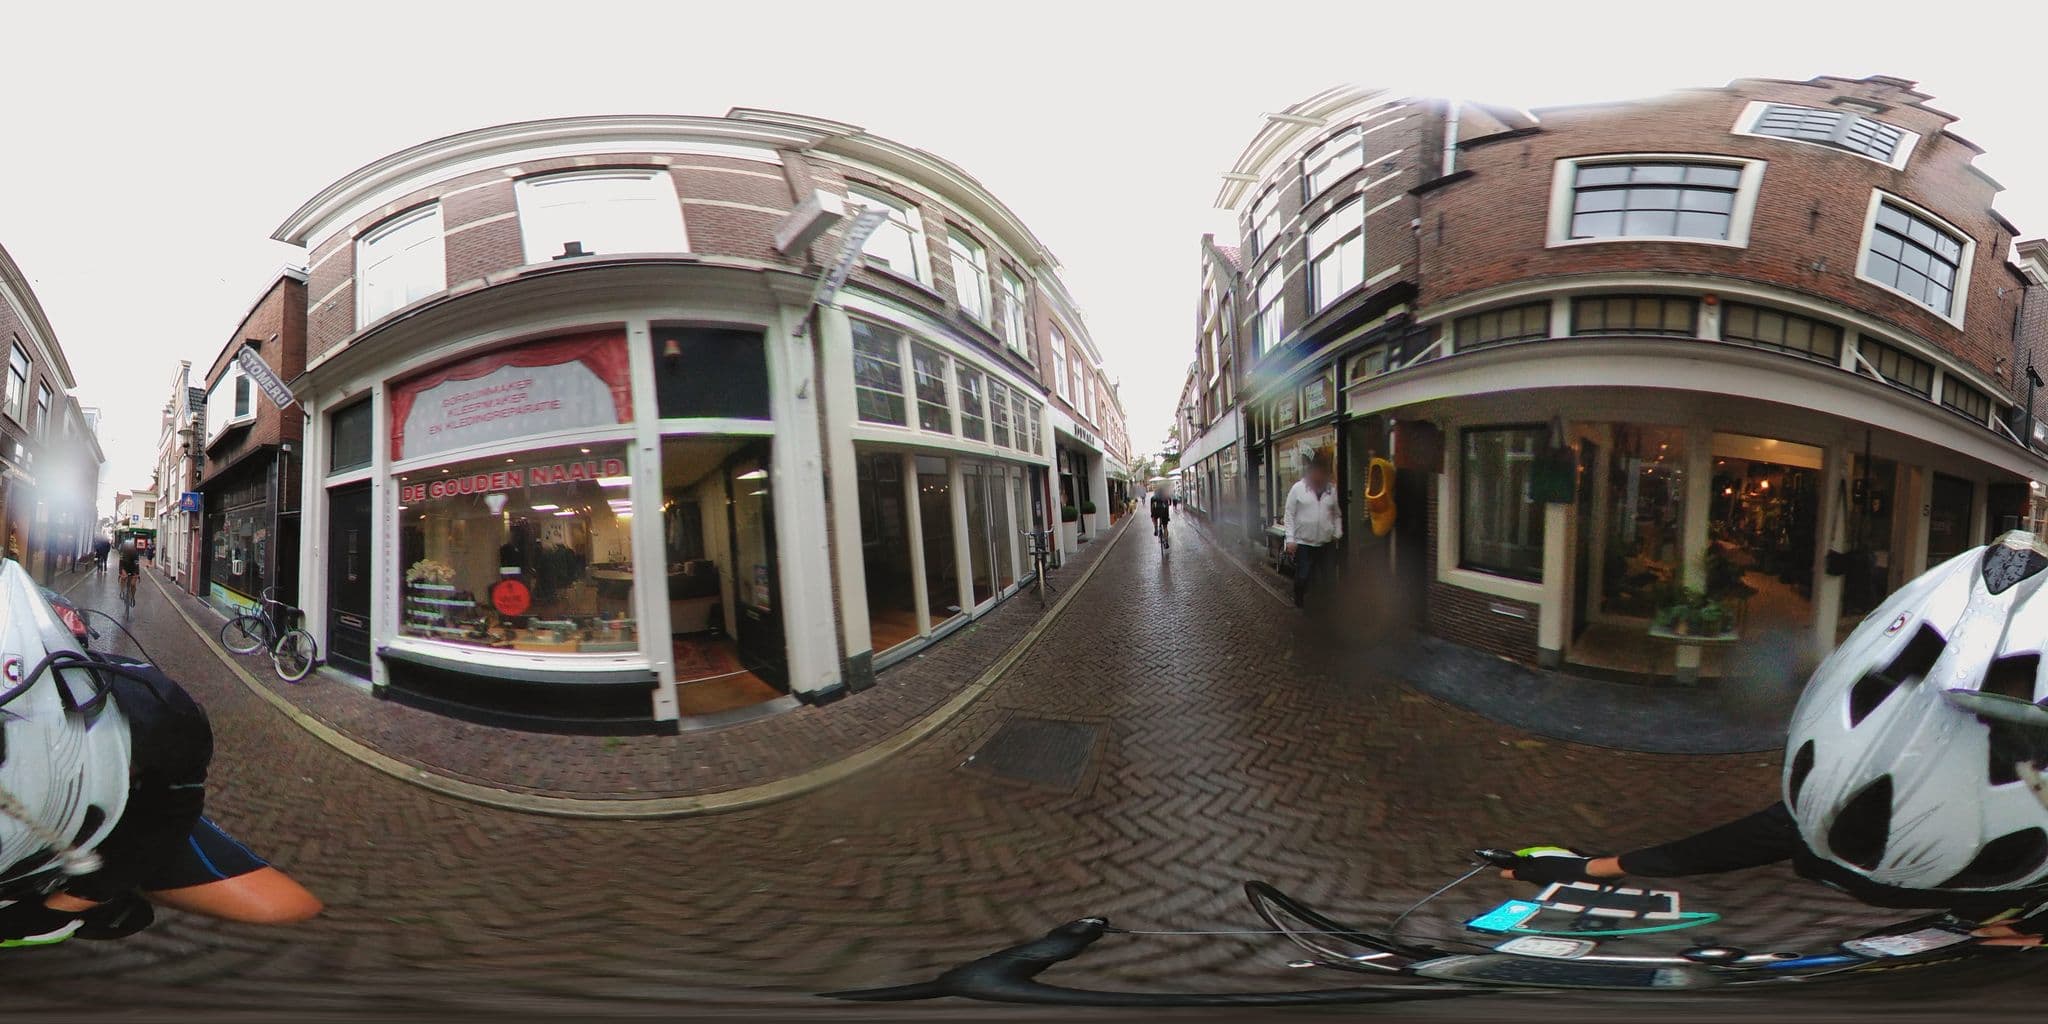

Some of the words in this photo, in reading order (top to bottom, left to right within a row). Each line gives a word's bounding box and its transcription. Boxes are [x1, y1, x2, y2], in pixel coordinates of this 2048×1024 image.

[403, 484, 425, 501] DE
[431, 470, 522, 497] GOUDEN
[530, 459, 623, 486] NAALD
